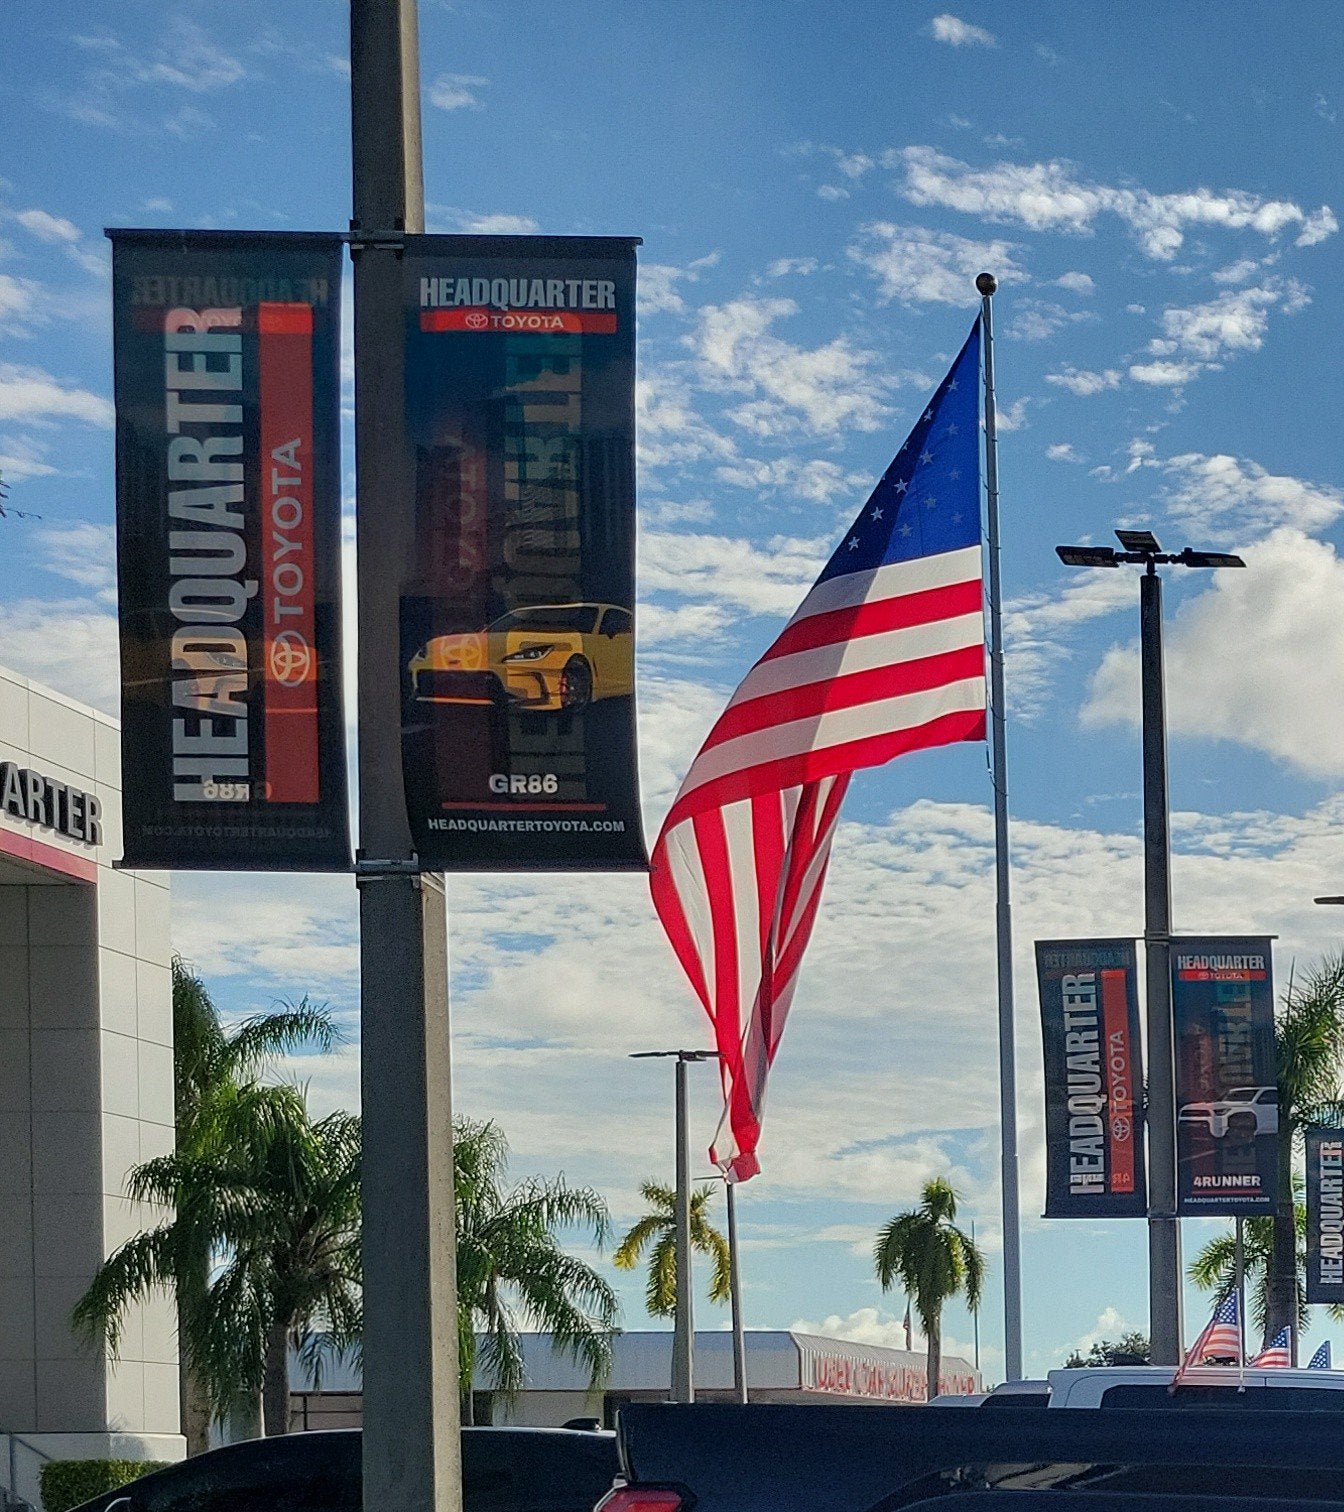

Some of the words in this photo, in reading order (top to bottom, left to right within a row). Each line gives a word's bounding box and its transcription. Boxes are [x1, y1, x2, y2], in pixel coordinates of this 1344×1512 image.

[419, 277, 616, 311] HEADQUARTER
[490, 315, 564, 329] TOYOTA
[271, 438, 303, 624] TOYOTA
[164, 306, 259, 802] HEADQUARTER
[489, 773, 558, 794] GR86
[428, 818, 625, 832] HEADQUARTERTOYOTA.COM
[1178, 955, 1265, 971] HEADQUARTER
[1210, 972, 1244, 980] TOYOTA
[1109, 1030, 1127, 1113] TOYOTA
[1061, 971, 1107, 1194] HEADQUARTER
[1193, 1175, 1261, 1187] 4RUNNER
